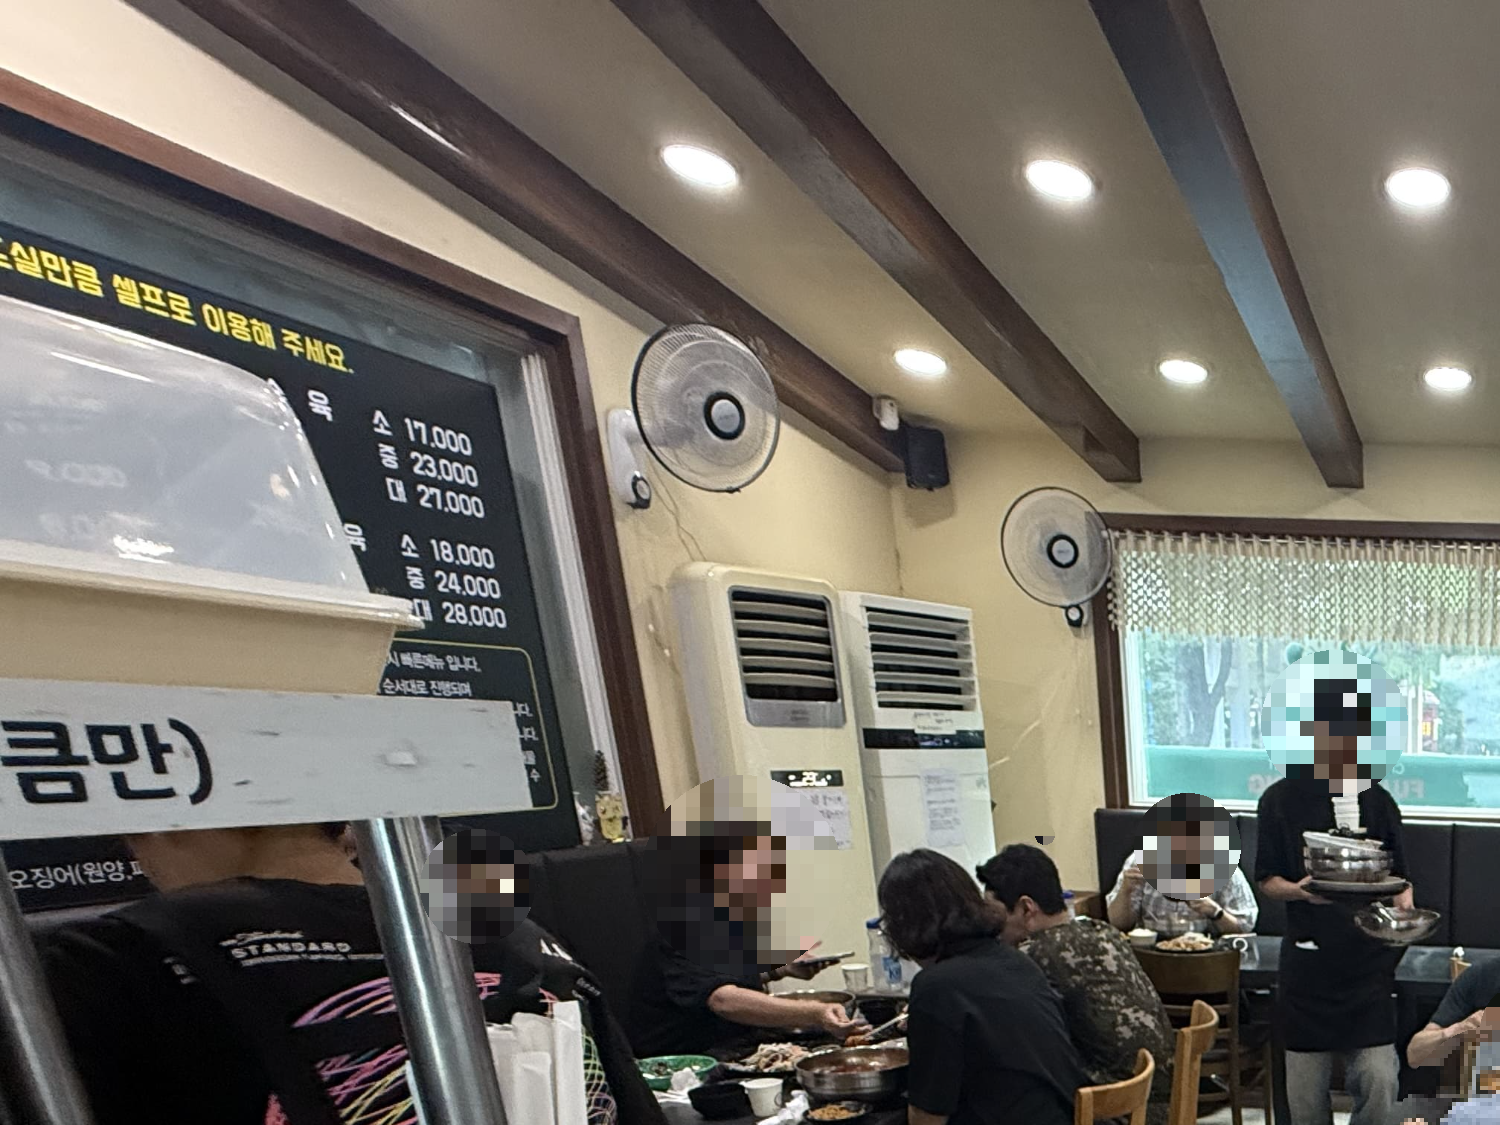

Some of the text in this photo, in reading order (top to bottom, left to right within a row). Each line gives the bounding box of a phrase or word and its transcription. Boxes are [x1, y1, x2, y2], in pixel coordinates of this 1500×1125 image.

[112, 273, 197, 326] 셀프로
[202, 303, 276, 350] 이용해
[280, 328, 354, 374] 주세요.
[372, 409, 393, 436] 소
[404, 417, 473, 457] 17.000
[378, 443, 479, 488] 중 23.000
[385, 477, 485, 519] 대 27.000
[401, 533, 420, 559] 소
[430, 538, 495, 570] 18.000
[406, 566, 502, 599] 중 24.000
[442, 601, 508, 629] 28.000
[445, 654, 482, 673] 입니다.
[382, 678, 430, 695] 순서대로
[231, 941, 351, 959] STANDARD
